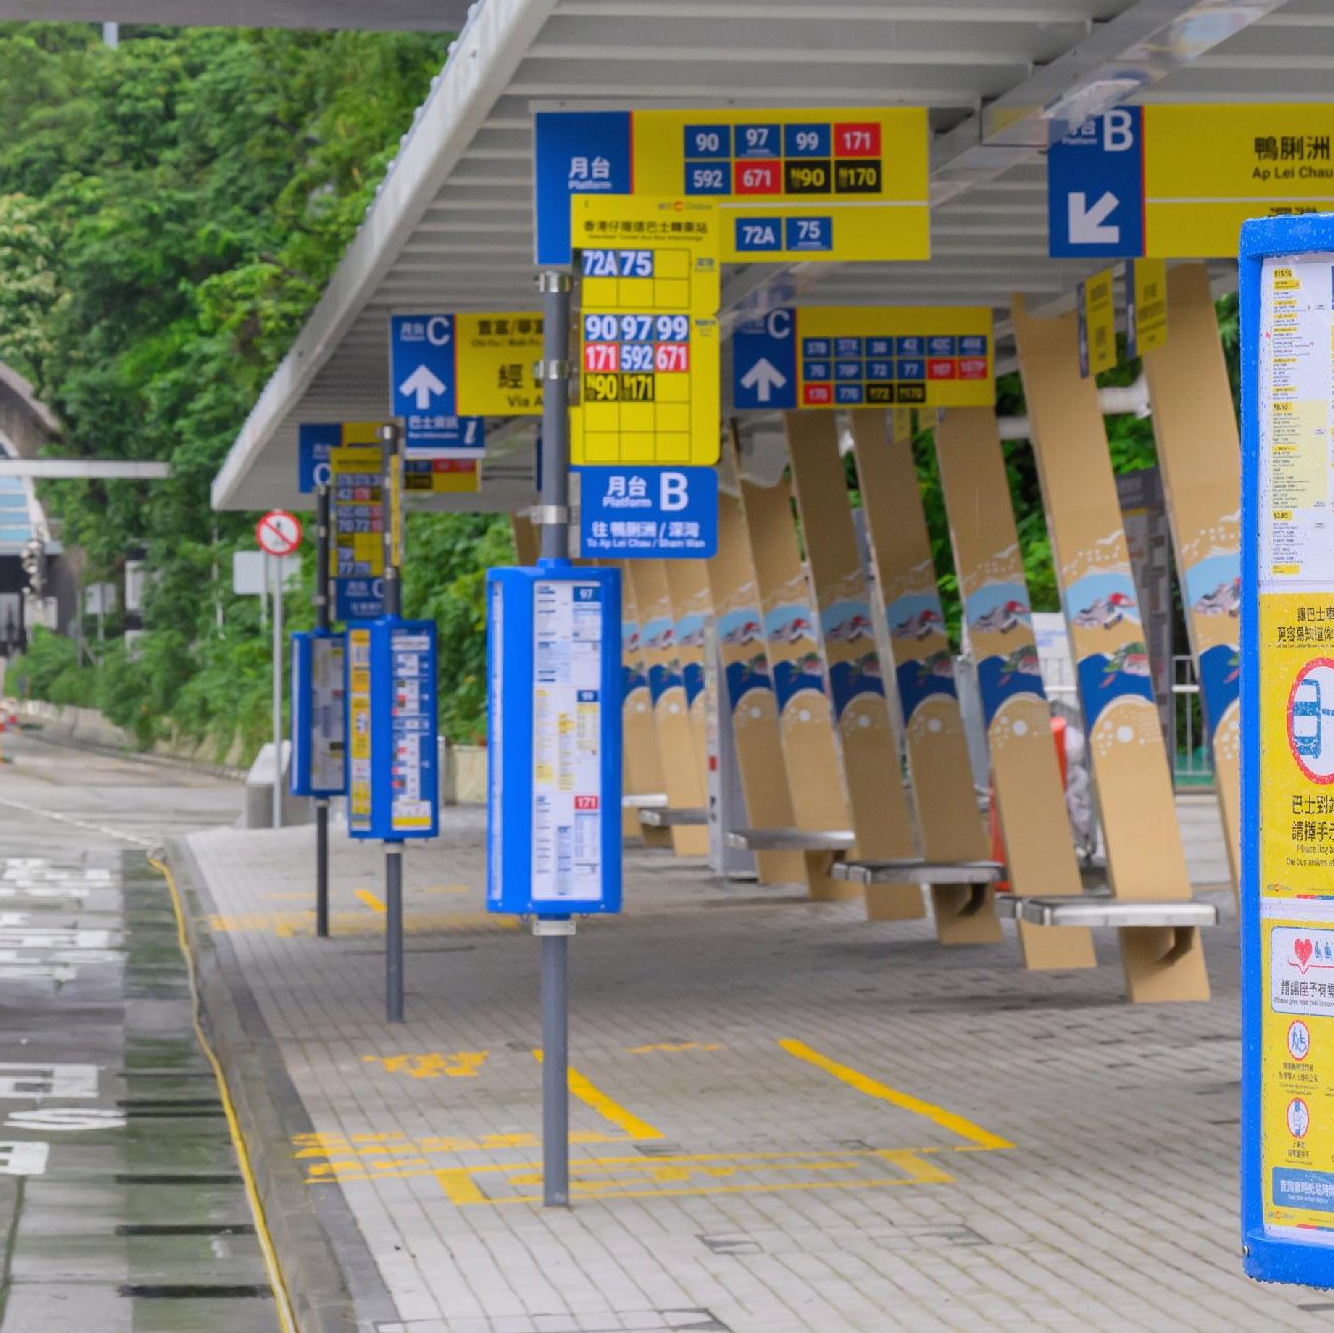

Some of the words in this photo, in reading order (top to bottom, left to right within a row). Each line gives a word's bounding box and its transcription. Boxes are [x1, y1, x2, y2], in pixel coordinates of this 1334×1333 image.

[695, 133, 719, 152] 90
[745, 128, 769, 146] 97
[795, 132, 819, 151] 99
[842, 132, 871, 151] 171
[1103, 110, 1134, 152] B
[568, 156, 611, 180] 月台
[693, 169, 723, 188] 592
[743, 169, 772, 187] 671
[1252, 167, 1271, 181] Ap
[1274, 167, 1295, 179] Lei
[1299, 166, 1334, 179] Chau
[742, 225, 776, 245] 72A
[796, 221, 821, 240] 75
[583, 250, 618, 276] 72A
[619, 250, 651, 277] 75
[426, 316, 451, 346] C
[586, 315, 617, 341] 90
[621, 315, 653, 341] 97
[656, 316, 688, 341] 99
[767, 309, 791, 340] C
[586, 344, 617, 370] 171
[620, 344, 654, 370] 592
[656, 345, 687, 370] 671
[607, 475, 647, 498] 月台
[659, 471, 689, 511] B
[603, 496, 652, 508] Platform
[576, 796, 596, 809] 171
